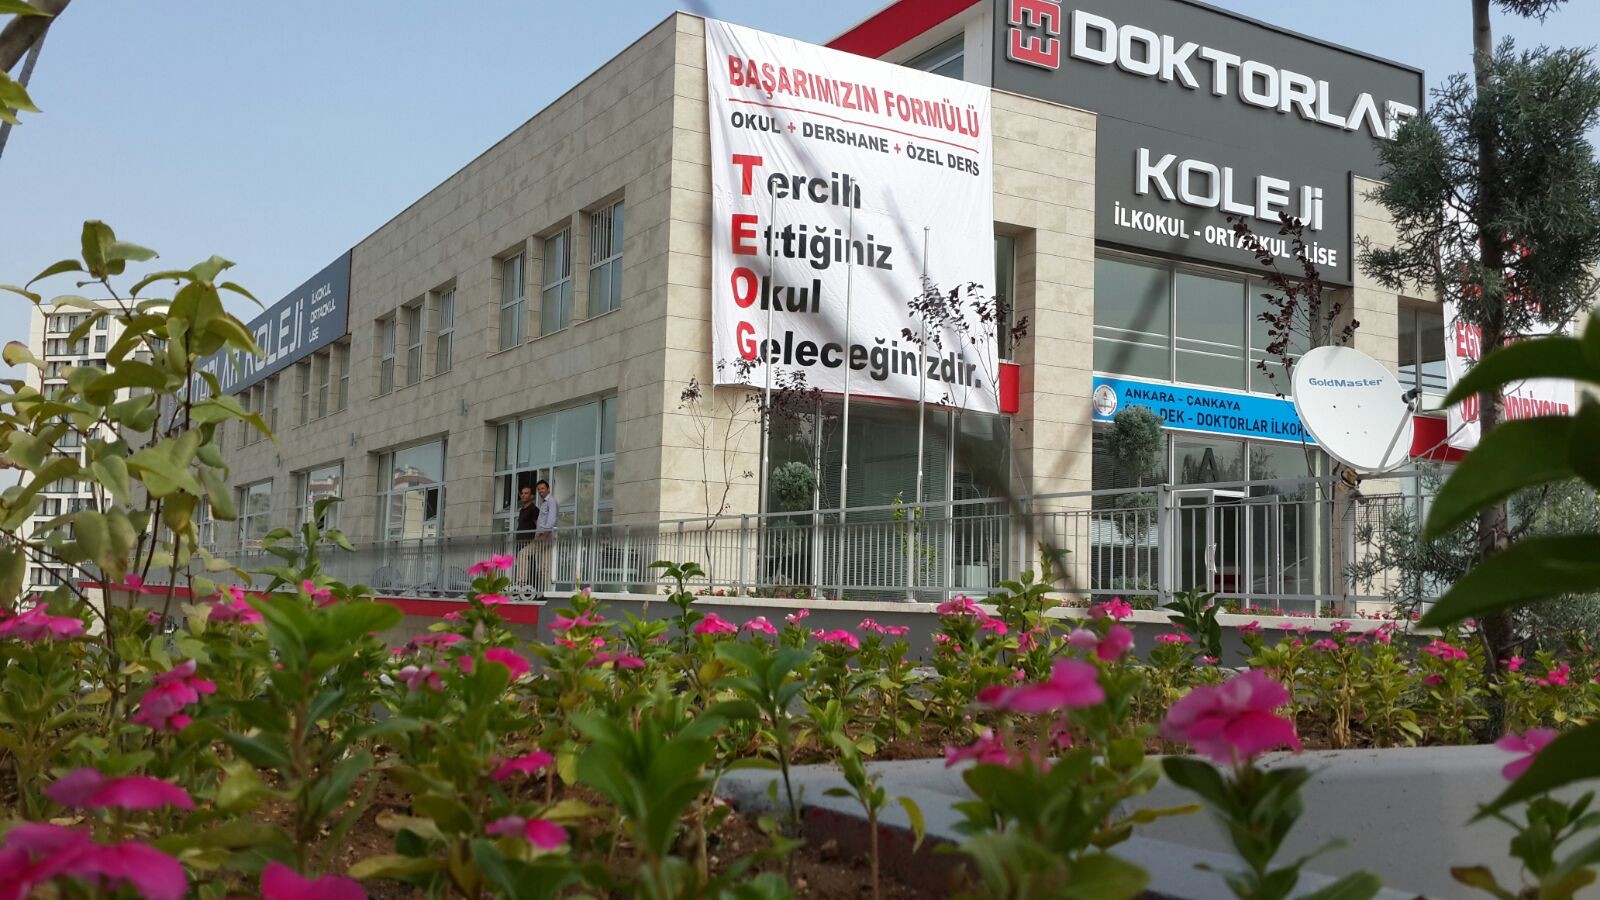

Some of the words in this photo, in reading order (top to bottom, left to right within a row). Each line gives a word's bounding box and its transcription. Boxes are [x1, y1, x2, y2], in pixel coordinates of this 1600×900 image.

[728, 54, 880, 115] BAŞARIMIZIN
[884, 90, 980, 138] FORMÜLÜ
[731, 111, 781, 134] OKUL
[802, 122, 889, 154] DERSHANE
[906, 141, 943, 166] ÖZEL
[947, 153, 980, 177] DERS
[732, 154, 861, 209] Tercih
[731, 213, 893, 271] Ettiğiniz
[1114, 201, 1190, 239] İLKOKUL
[730, 266, 822, 314] Okul
[1125, 387, 1175, 403] ANKARA
[1186, 395, 1240, 411] ÇANKAYA
[1309, 377, 1383, 387] GoldMaster
[1197, 412, 1268, 433] DOKTORLAR
